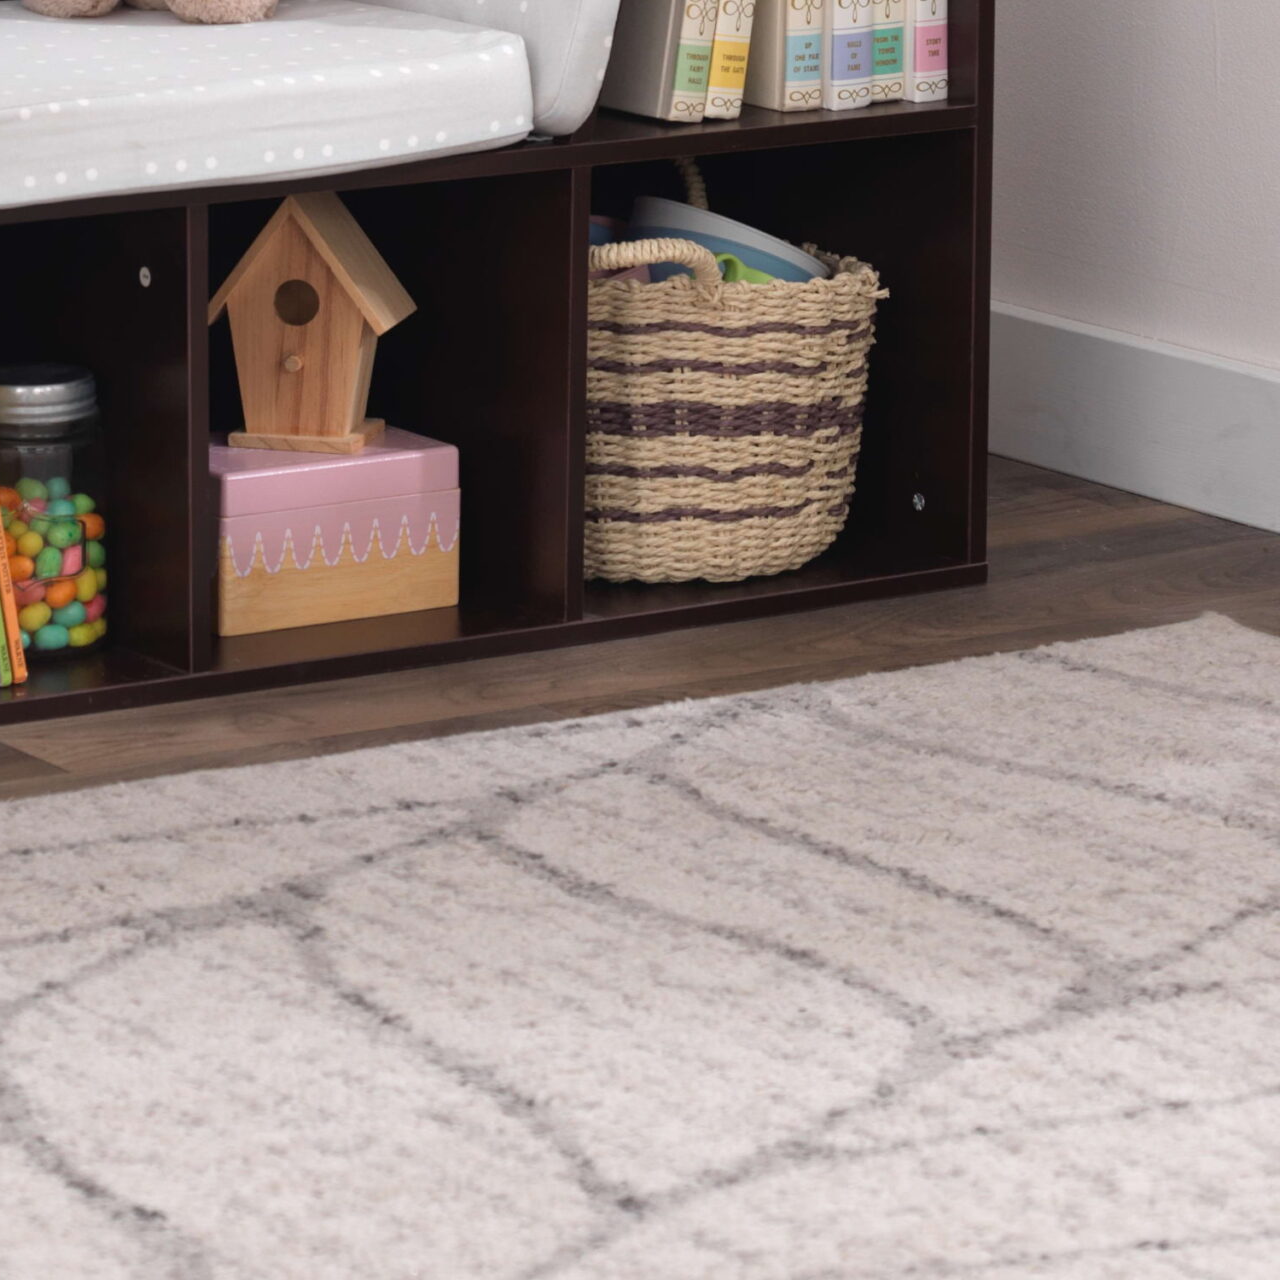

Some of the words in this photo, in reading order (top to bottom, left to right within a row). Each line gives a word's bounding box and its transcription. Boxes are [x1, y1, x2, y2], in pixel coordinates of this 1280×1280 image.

[1, 562, 11, 594] POTTER
[0, 643, 10, 672] WARNE
[13, 638, 24, 667] WARNE
